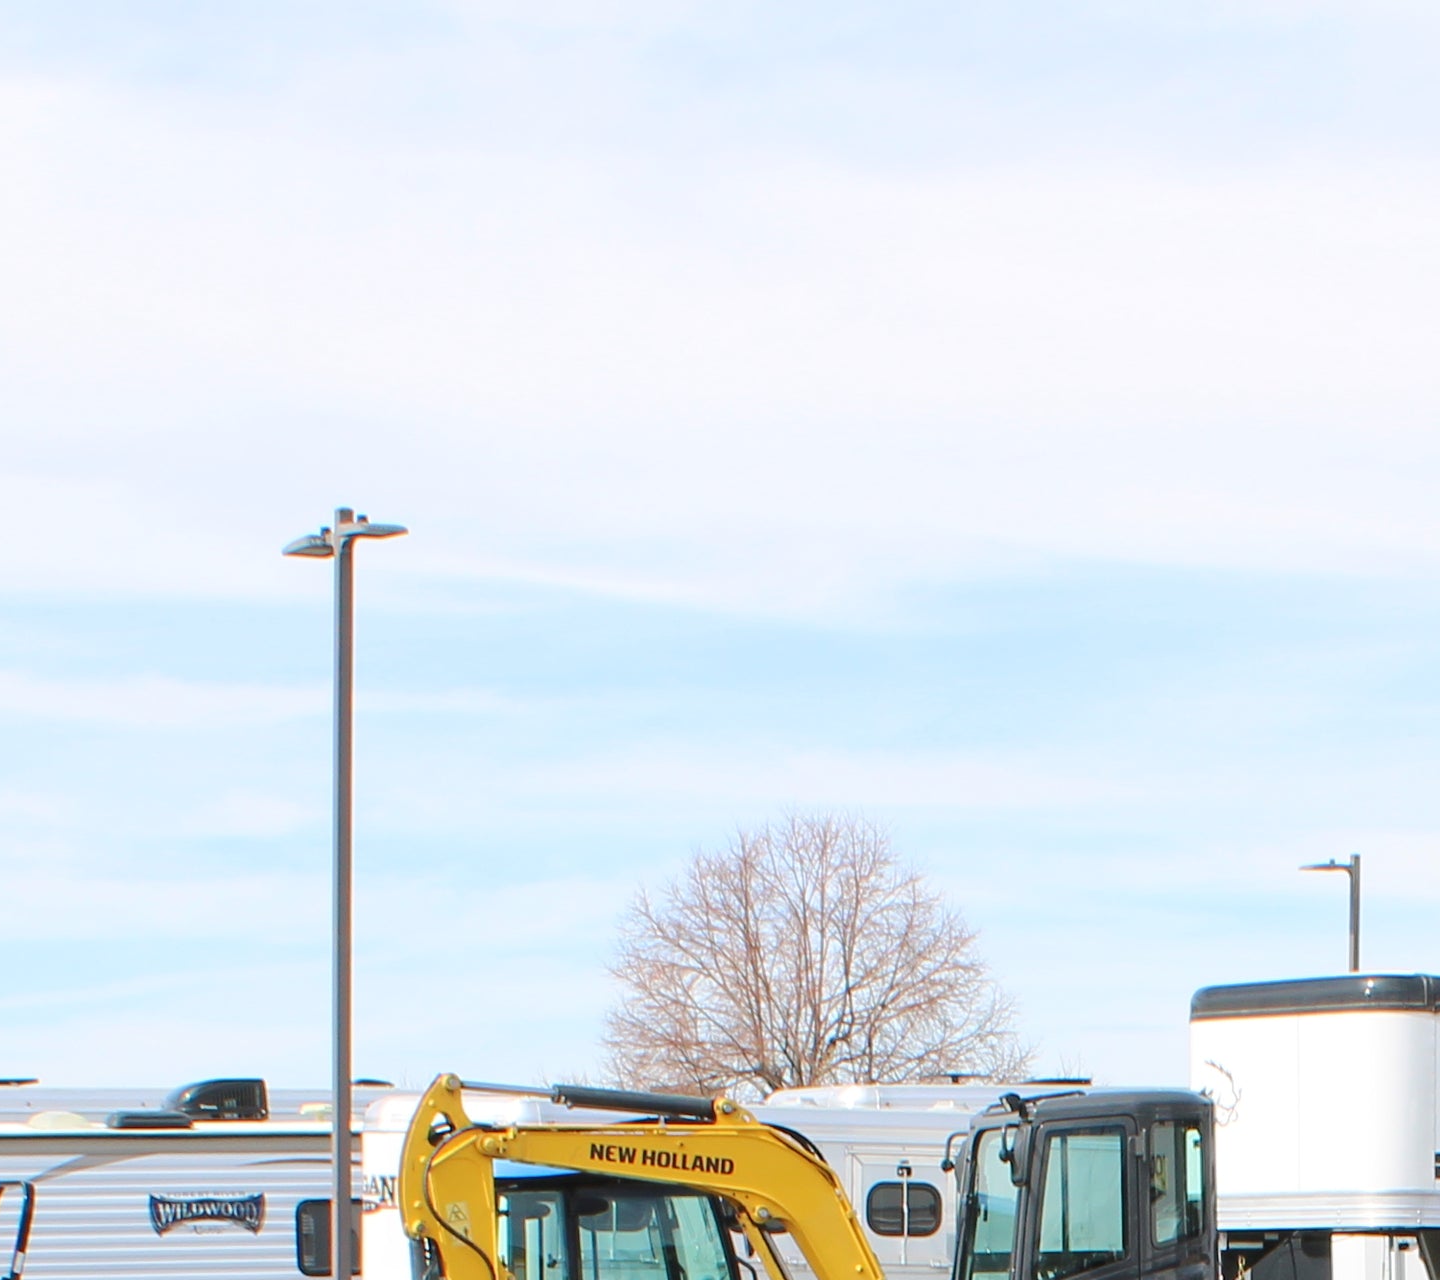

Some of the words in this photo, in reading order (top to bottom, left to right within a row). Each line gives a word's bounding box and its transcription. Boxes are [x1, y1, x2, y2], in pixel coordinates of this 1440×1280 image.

[590, 1142, 637, 1165] NEW
[641, 1148, 735, 1176] HOLLAND
[157, 1199, 259, 1226] WILDWOOD
